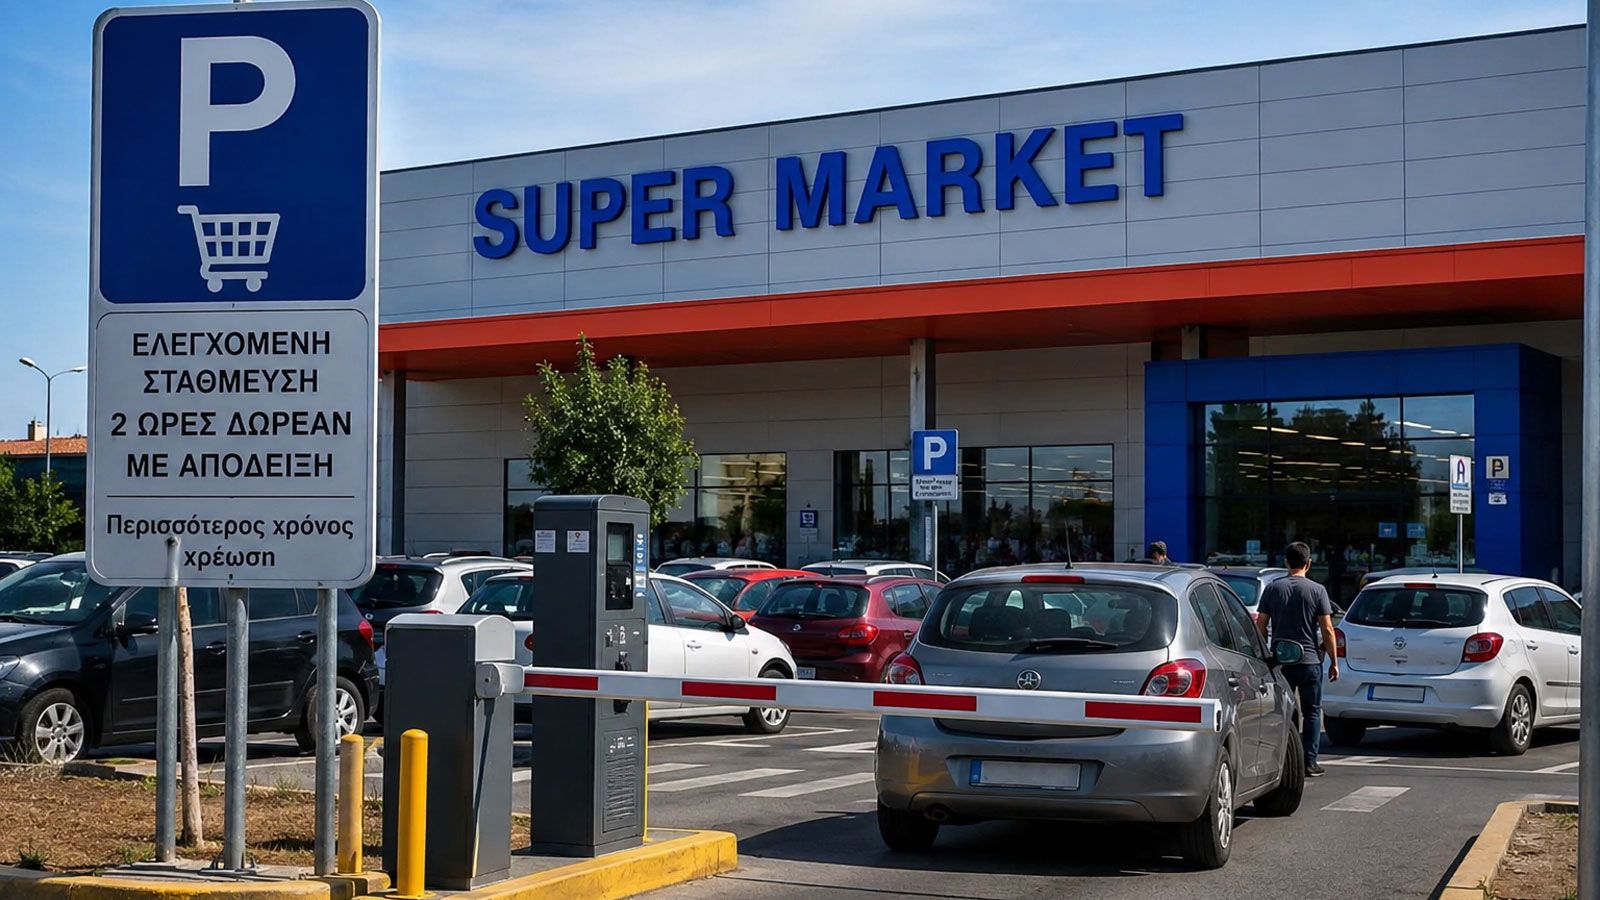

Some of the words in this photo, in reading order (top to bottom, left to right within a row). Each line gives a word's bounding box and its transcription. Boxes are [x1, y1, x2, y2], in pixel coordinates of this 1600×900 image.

[180, 36, 295, 187] P
[473, 164, 734, 260] SUPER
[775, 112, 1185, 231] MARKET
[133, 331, 330, 357] ΕΛΕΓΧΟΜΕΝΗ
[143, 369, 318, 394] ΣΤΑΘΜΕΥΣΗ
[110, 412, 127, 437] 2
[138, 411, 217, 437] ΩΡΕΣ
[227, 411, 352, 436] ΔΩΡΕΑΝ
[127, 453, 169, 478] ΜΕ
[179, 452, 333, 478] ΑΠΟΔΕΙΞΗ
[924, 436, 947, 470] P
[1491, 458, 1504, 478] P
[107, 513, 266, 540] Περισσότερος
[273, 513, 354, 540] χρόνος
